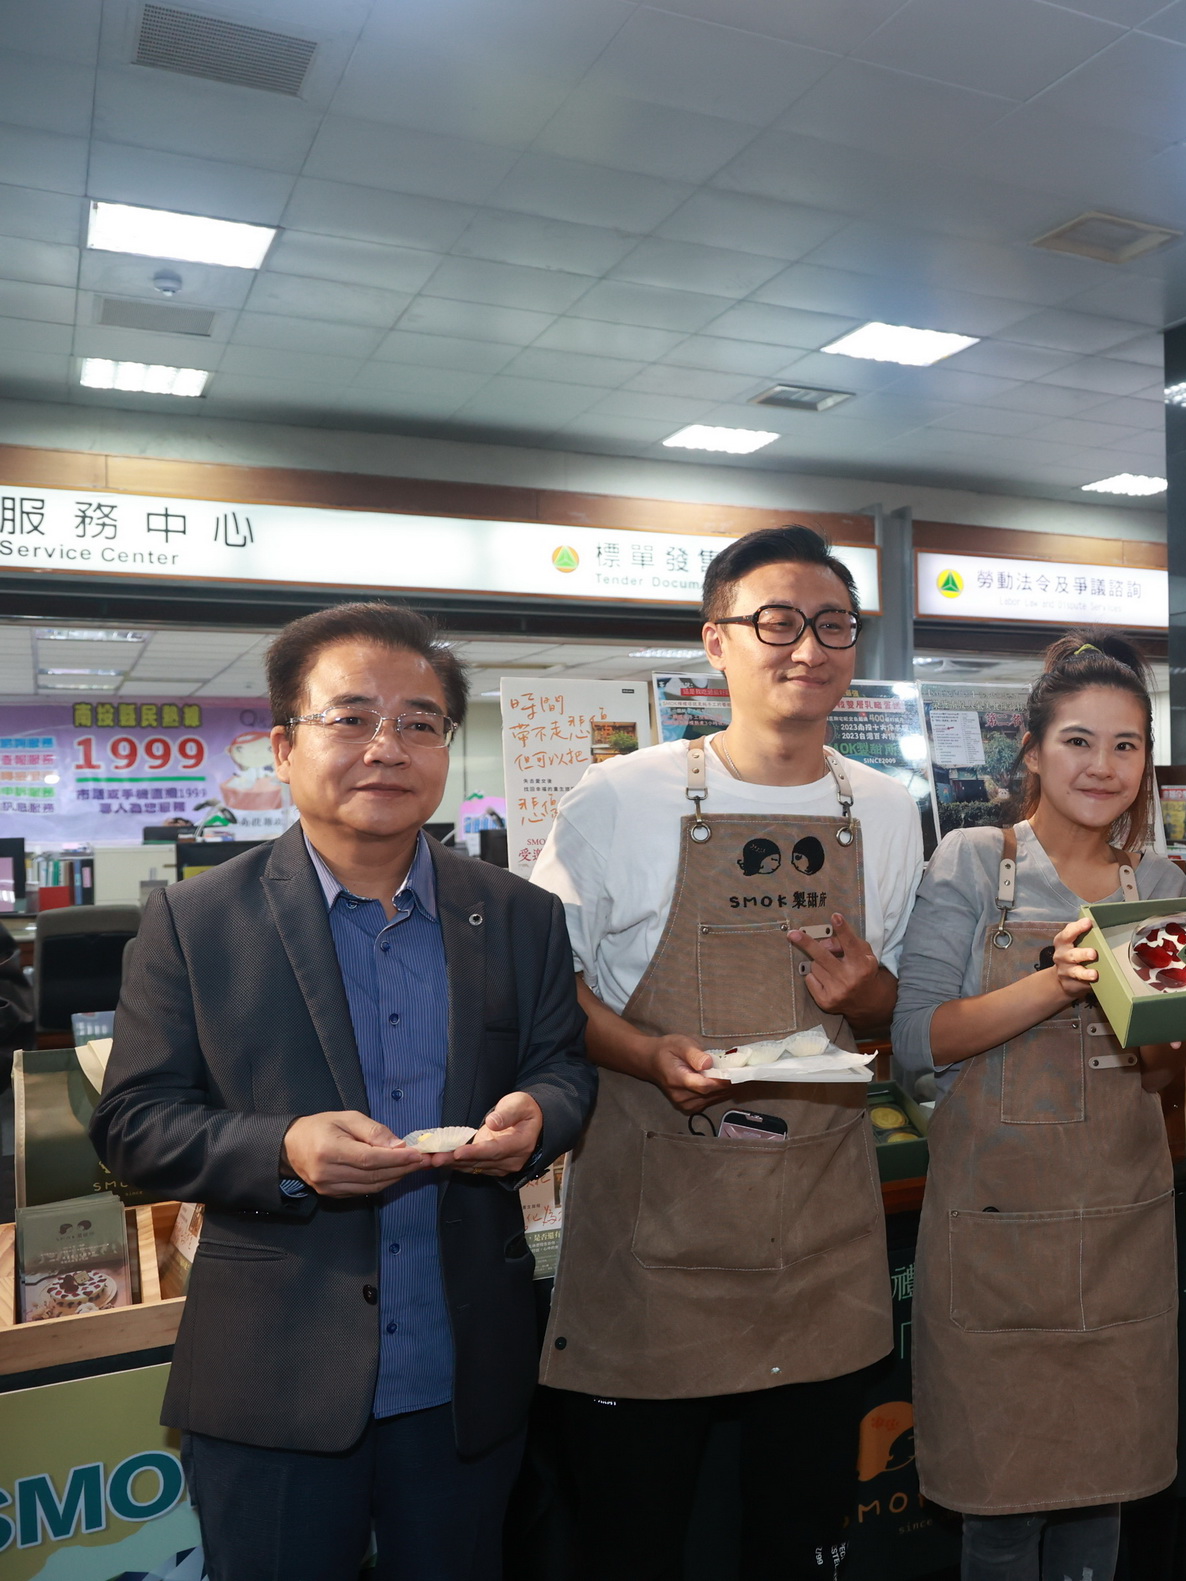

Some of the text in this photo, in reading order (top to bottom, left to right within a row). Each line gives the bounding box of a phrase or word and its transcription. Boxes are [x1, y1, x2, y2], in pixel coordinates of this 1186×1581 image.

[0, 496, 254, 548] 服務中心
[0, 540, 179, 565] Service Center
[596, 573, 702, 590] Tender Docum
[74, 737, 206, 770] 1999
[729, 894, 788, 909] SMOK
